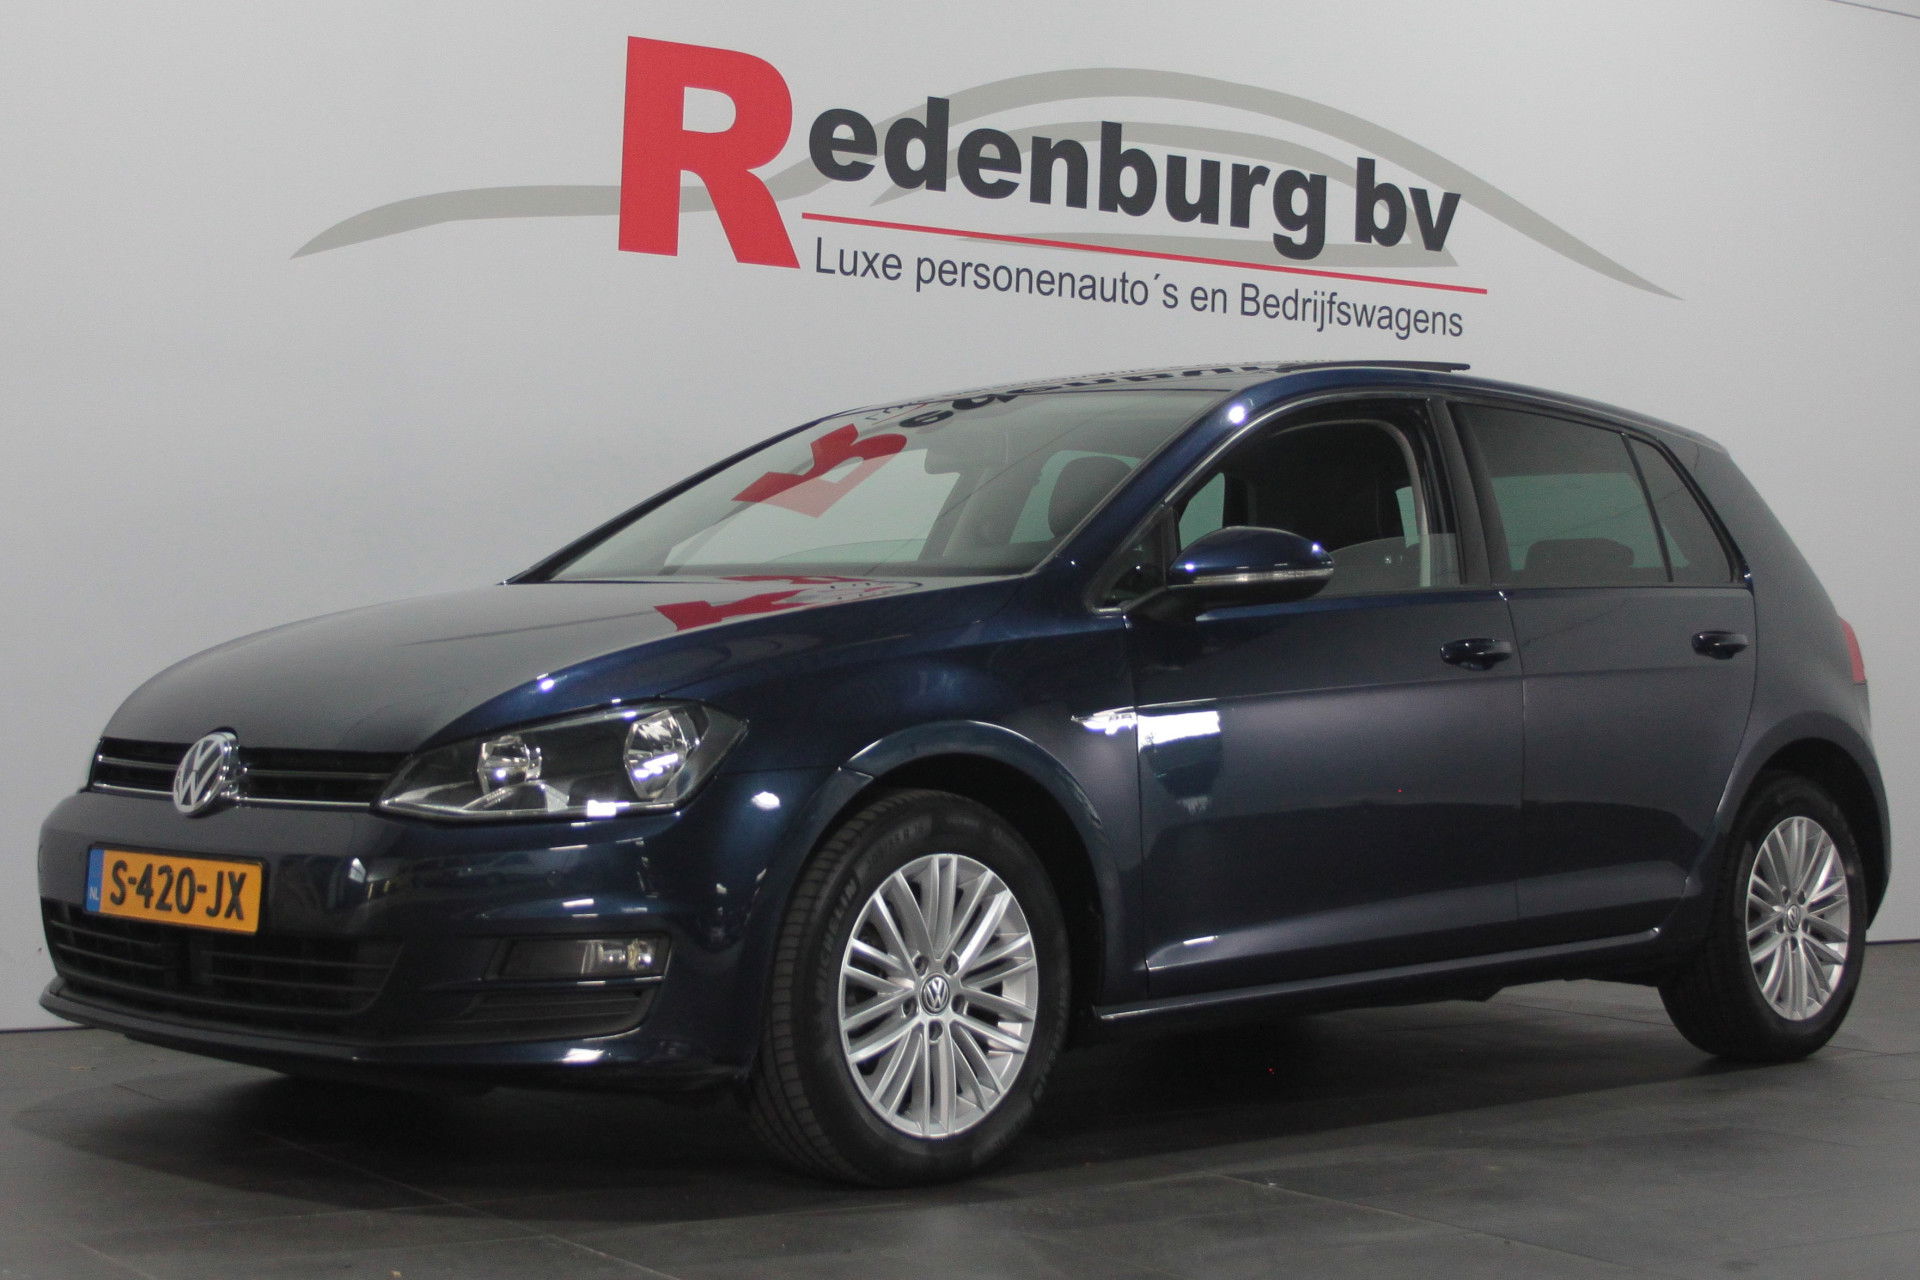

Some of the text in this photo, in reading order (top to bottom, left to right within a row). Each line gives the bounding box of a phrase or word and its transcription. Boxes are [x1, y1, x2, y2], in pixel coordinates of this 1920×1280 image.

[619, 36, 1461, 268] Redenburg bv
[815, 237, 902, 280] Luxe
[1190, 286, 1227, 314] en
[1240, 283, 1463, 340] Bedrijfswagens
[89, 886, 99, 900] NL
[110, 860, 247, 921] S-420-JX
